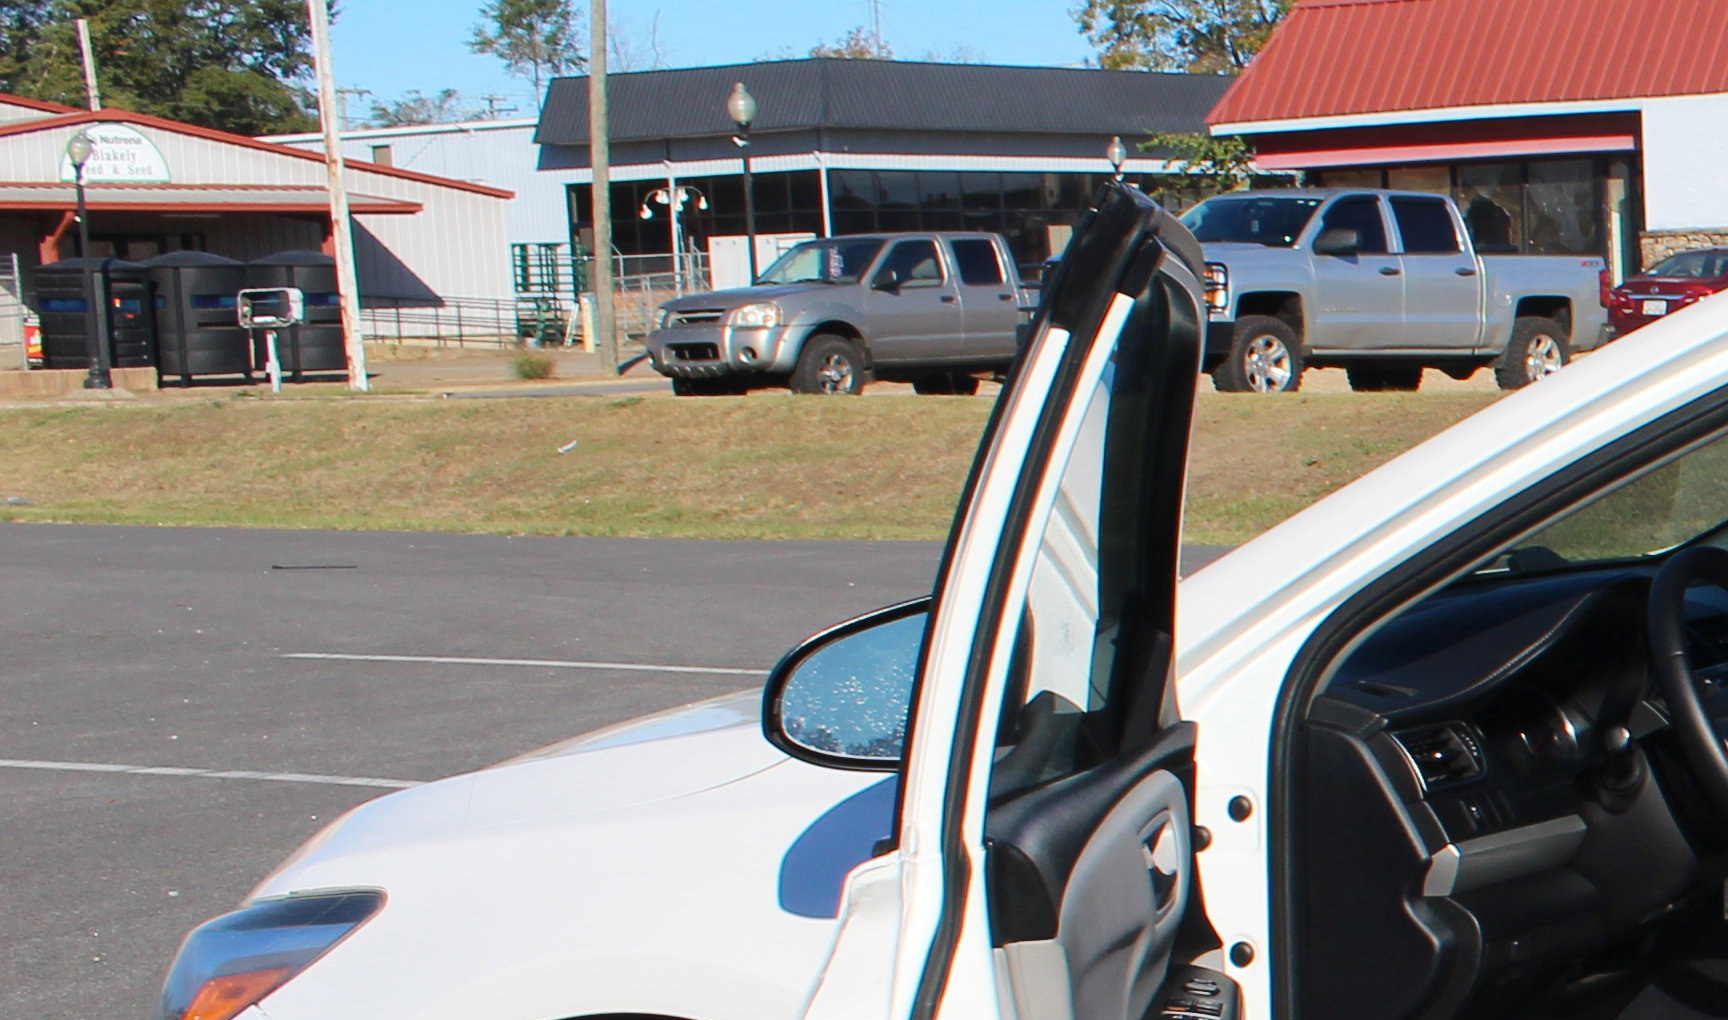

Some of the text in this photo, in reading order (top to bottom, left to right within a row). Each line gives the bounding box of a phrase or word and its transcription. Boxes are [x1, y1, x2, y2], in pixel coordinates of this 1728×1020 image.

[99, 135, 142, 145] Nutrena
[93, 149, 137, 163] Blakely
[112, 164, 120, 176] &
[128, 164, 153, 176] Seed
